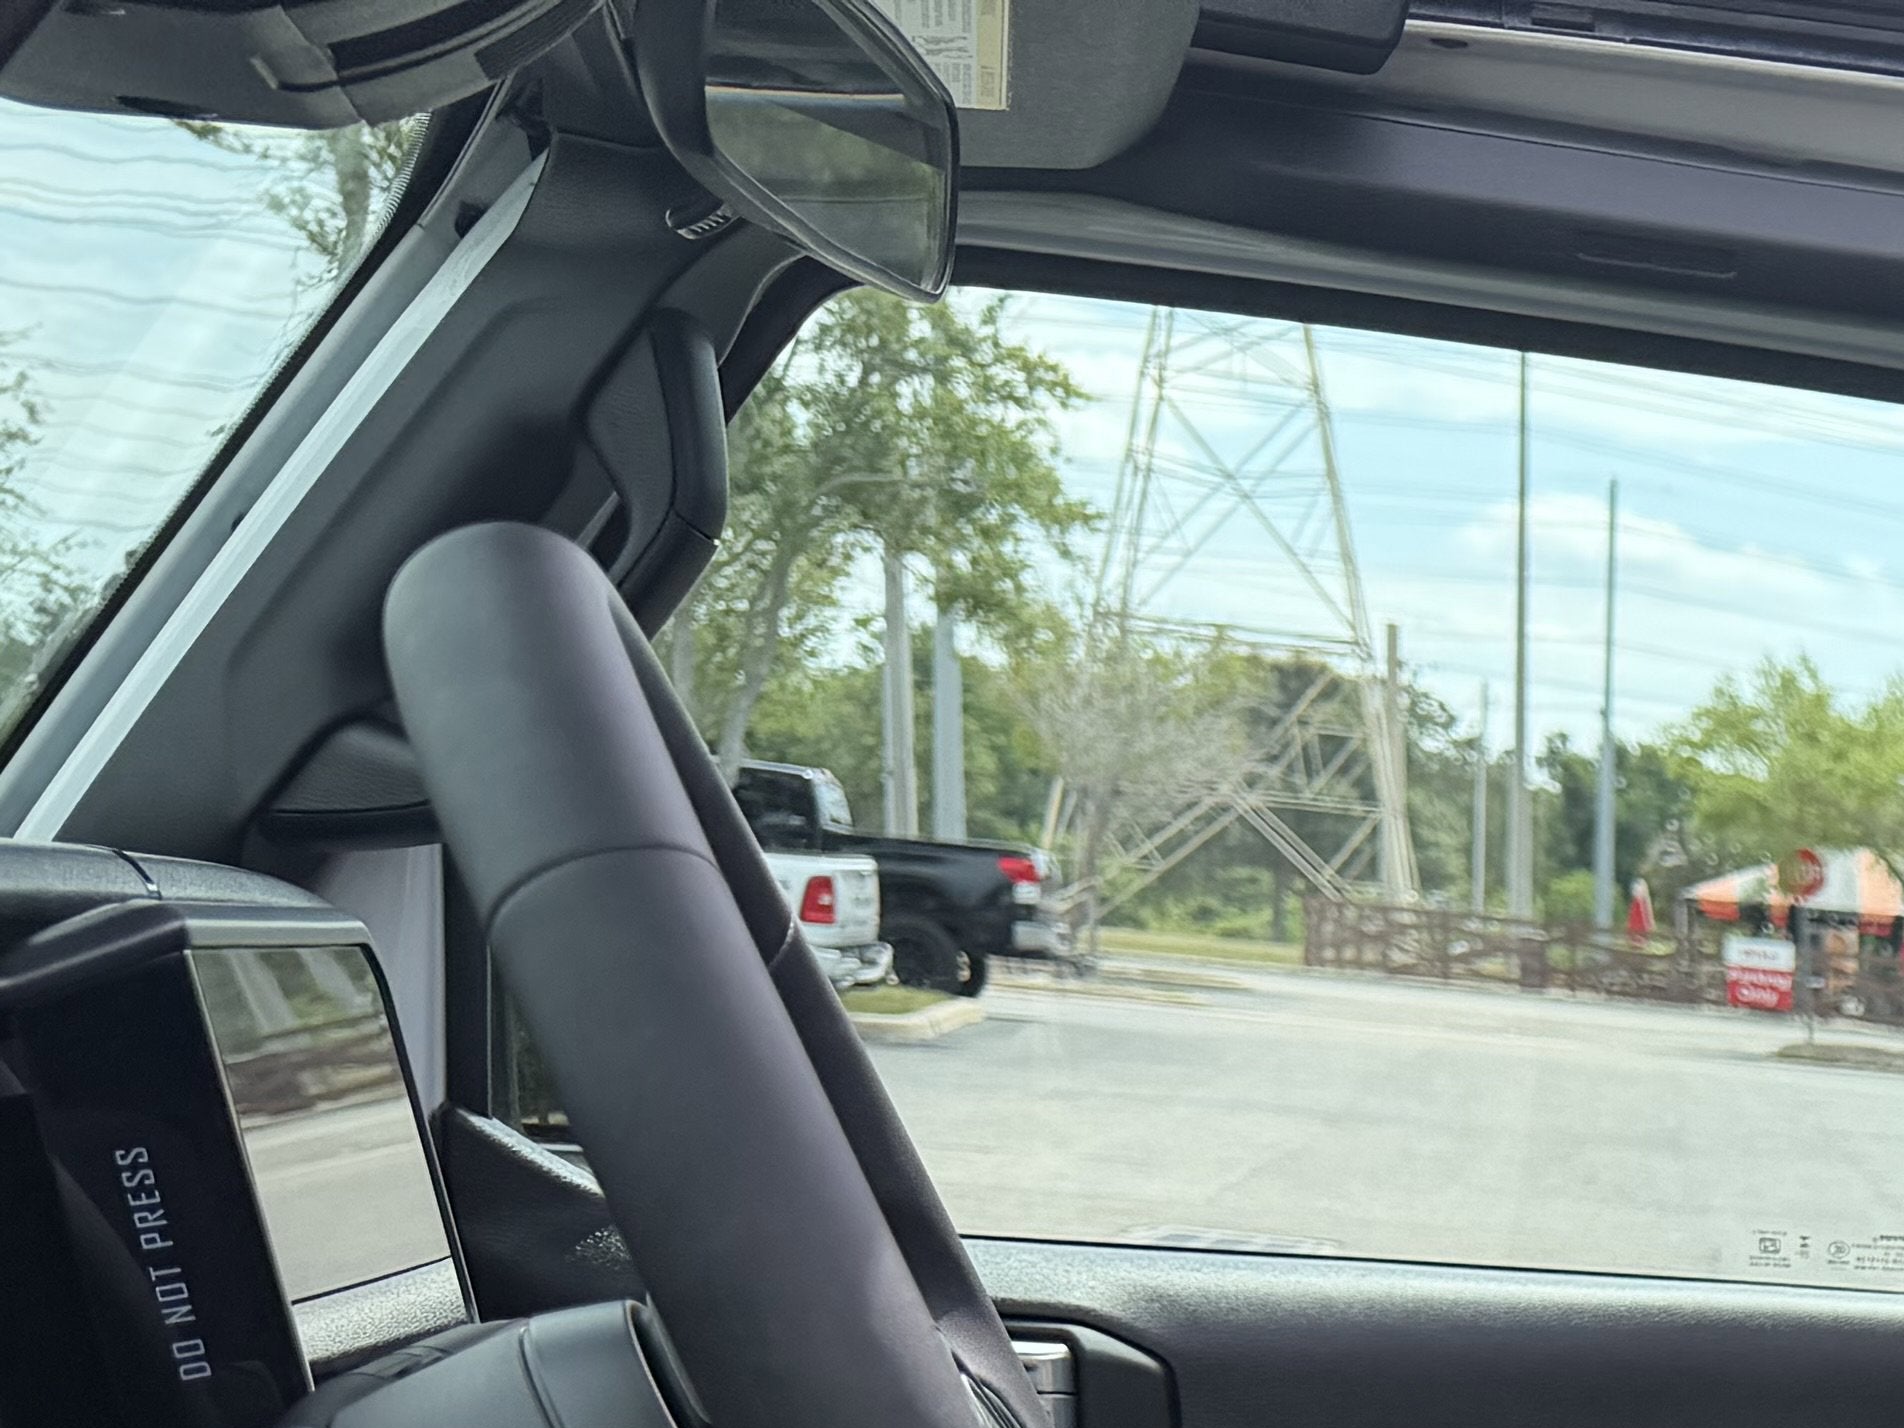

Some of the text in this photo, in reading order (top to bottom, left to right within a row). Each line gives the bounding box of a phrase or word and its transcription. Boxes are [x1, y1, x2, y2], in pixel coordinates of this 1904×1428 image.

[115, 1146, 213, 1381] DO NOT PRESS
